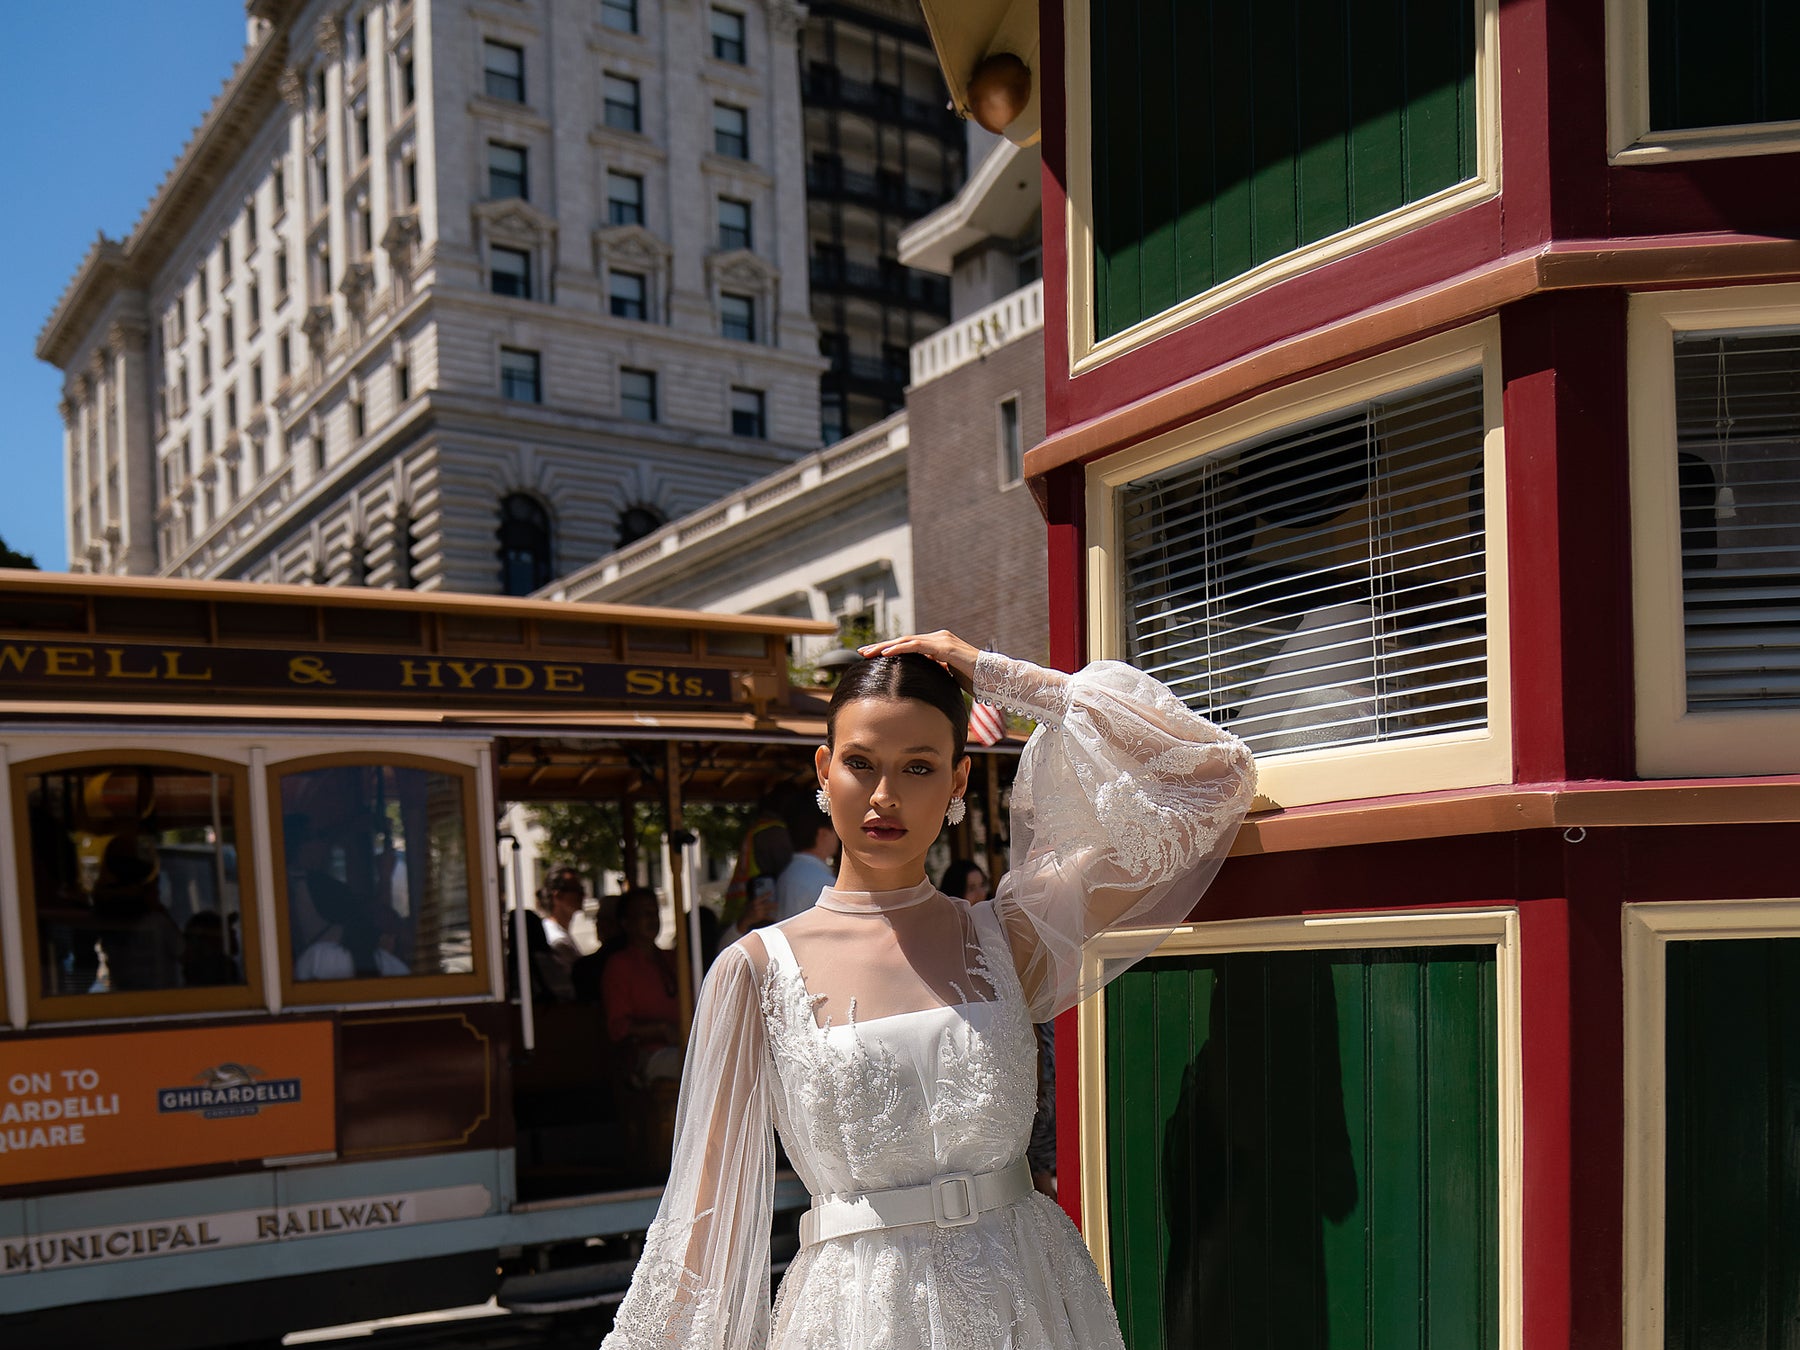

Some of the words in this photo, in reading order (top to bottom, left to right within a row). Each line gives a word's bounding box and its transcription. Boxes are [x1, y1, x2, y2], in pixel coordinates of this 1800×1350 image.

[288, 655, 336, 685] &
[400, 660, 586, 693] HYDE
[625, 668, 716, 697] Sts.
[8, 1072, 52, 1096] ON
[60, 1067, 100, 1092] TO
[162, 1082, 297, 1109] GHIRARDELLI
[0, 1093, 120, 1125] ARDELLI
[3, 1222, 220, 1271] MUNICIPAL
[256, 1200, 407, 1240] RAILWAY
